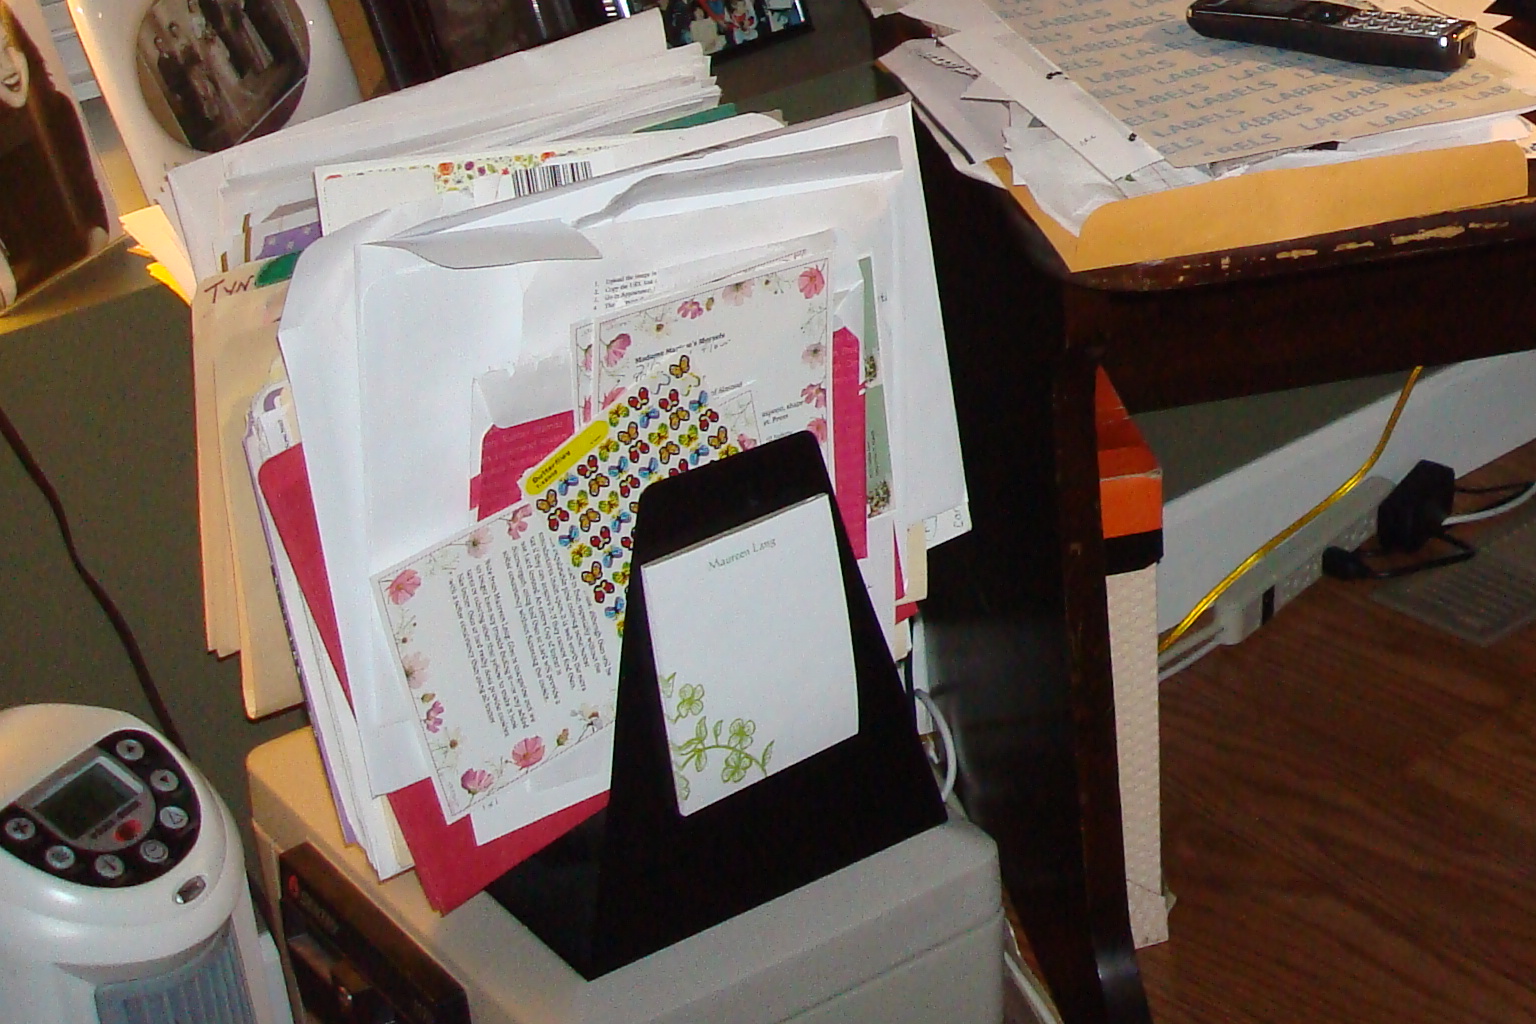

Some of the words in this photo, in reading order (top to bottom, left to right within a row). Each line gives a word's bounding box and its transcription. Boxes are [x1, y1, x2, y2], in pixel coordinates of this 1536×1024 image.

[1024, 9, 1112, 30] LABELS
[1090, 11, 1176, 34] LABELS
[1055, 35, 1143, 56] LABELS
[1085, 59, 1176, 83] LABELS
[1117, 83, 1210, 111] LABELS
[1186, 80, 1278, 110] LABELS
[1262, 78, 1352, 104] LABELS
[1404, 72, 1490, 99] LABELS
[1152, 108, 1246, 137] LABELS
[1222, 104, 1314, 134] LABELS
[1299, 100, 1390, 131] LABELS
[1367, 97, 1457, 128] LABELS
[708, 549, 750, 569] Maureen
[753, 538, 776, 553] Lang
